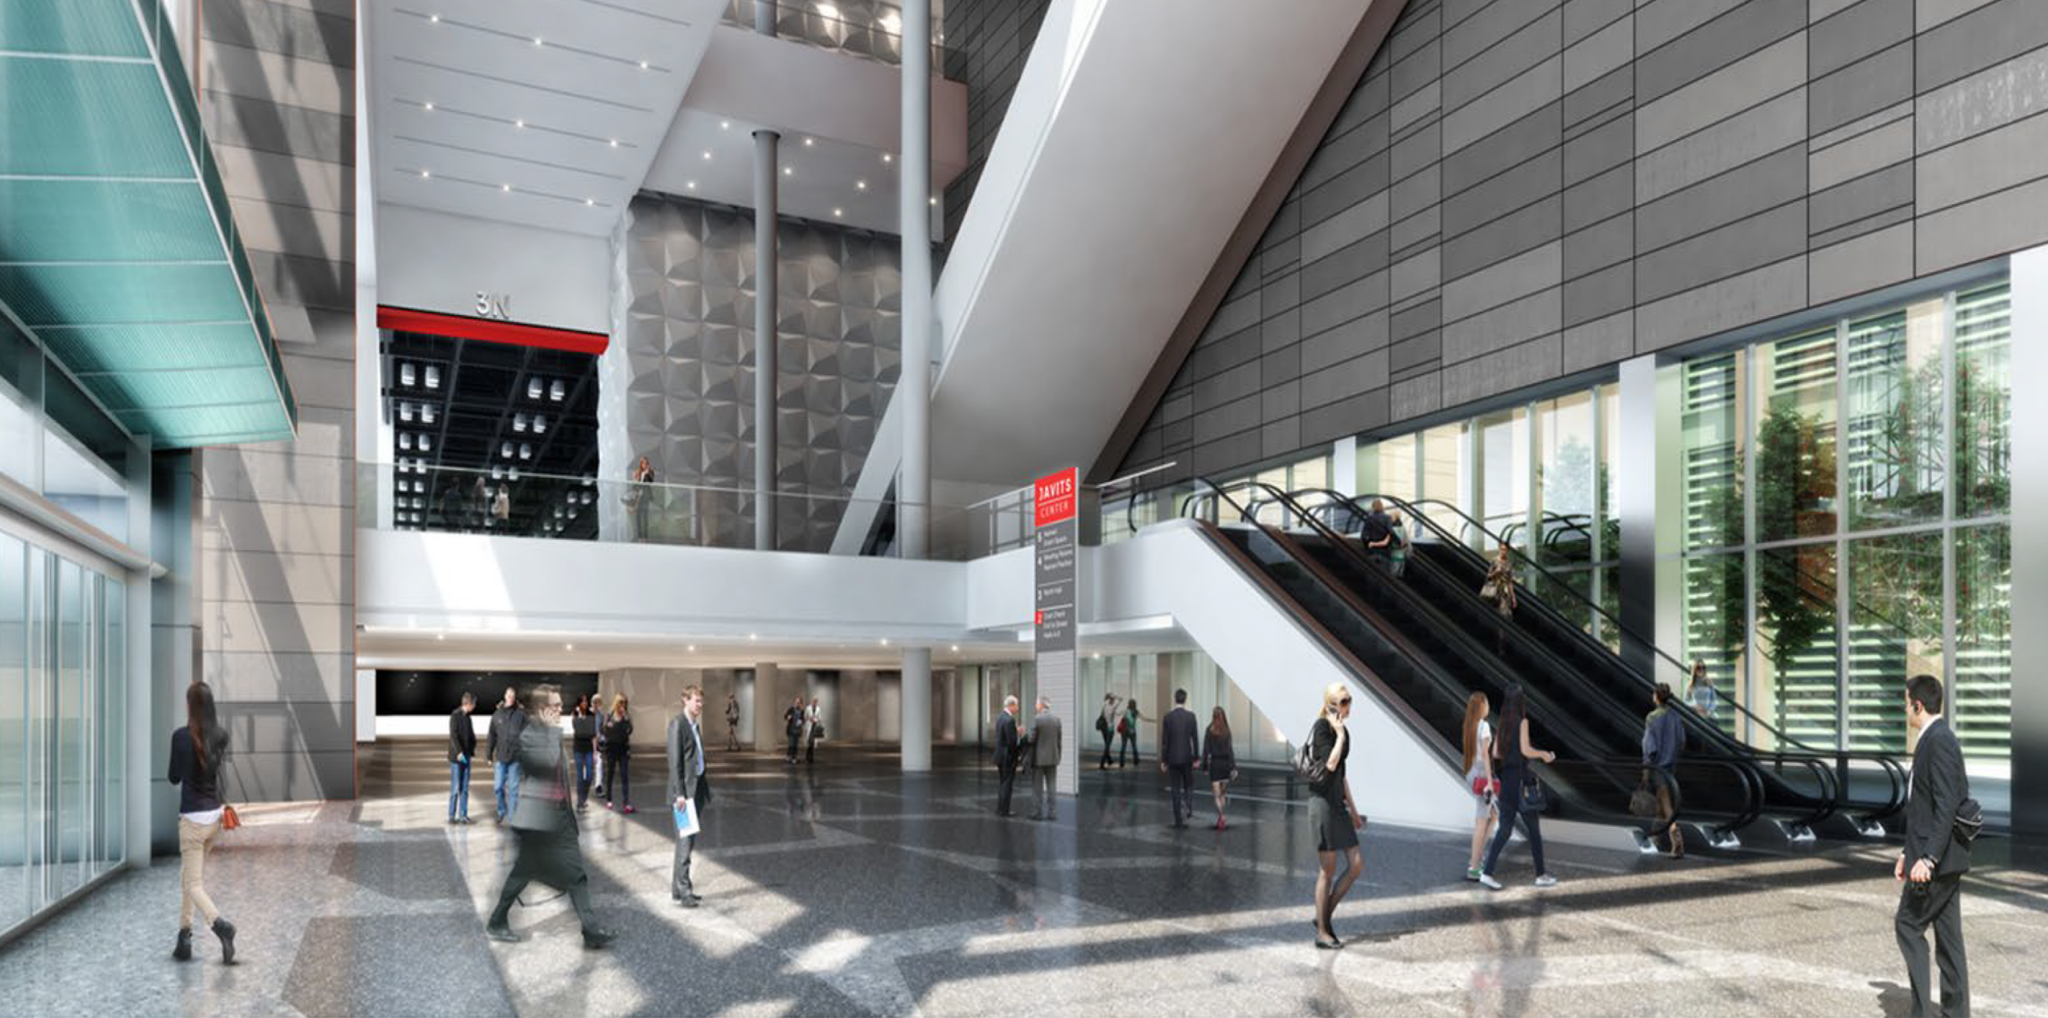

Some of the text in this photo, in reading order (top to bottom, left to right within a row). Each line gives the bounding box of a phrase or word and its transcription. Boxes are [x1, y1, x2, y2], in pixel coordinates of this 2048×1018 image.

[475, 291, 512, 320] 3N
[1038, 478, 1072, 500] JAVITS
[1040, 501, 1069, 518] CENTER
